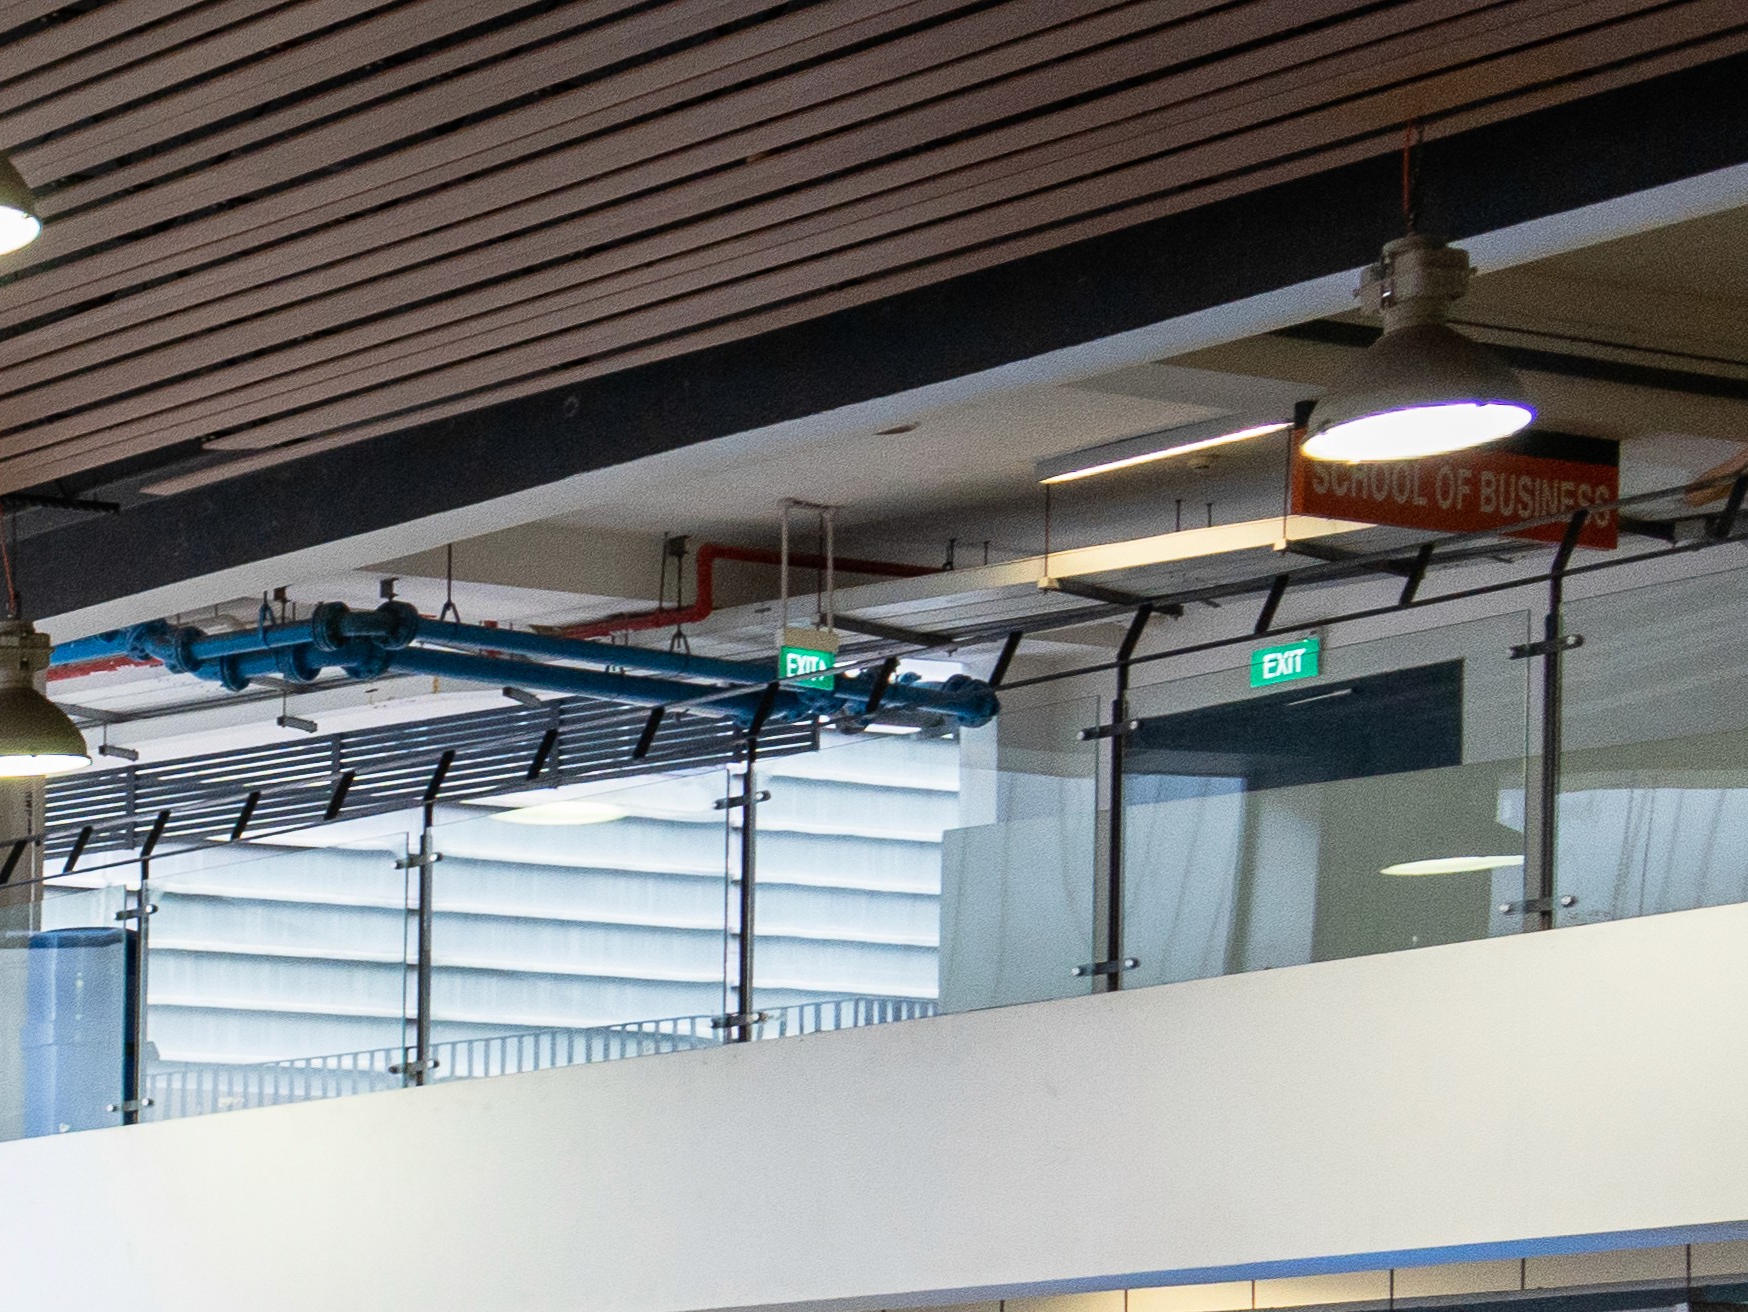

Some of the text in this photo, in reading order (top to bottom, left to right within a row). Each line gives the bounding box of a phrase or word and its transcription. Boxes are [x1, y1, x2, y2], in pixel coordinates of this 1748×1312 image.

[1312, 462, 1610, 527] SCHOOL OF BUSINESS
[786, 652, 820, 678] EXIT
[1262, 648, 1306, 679] EXIT
